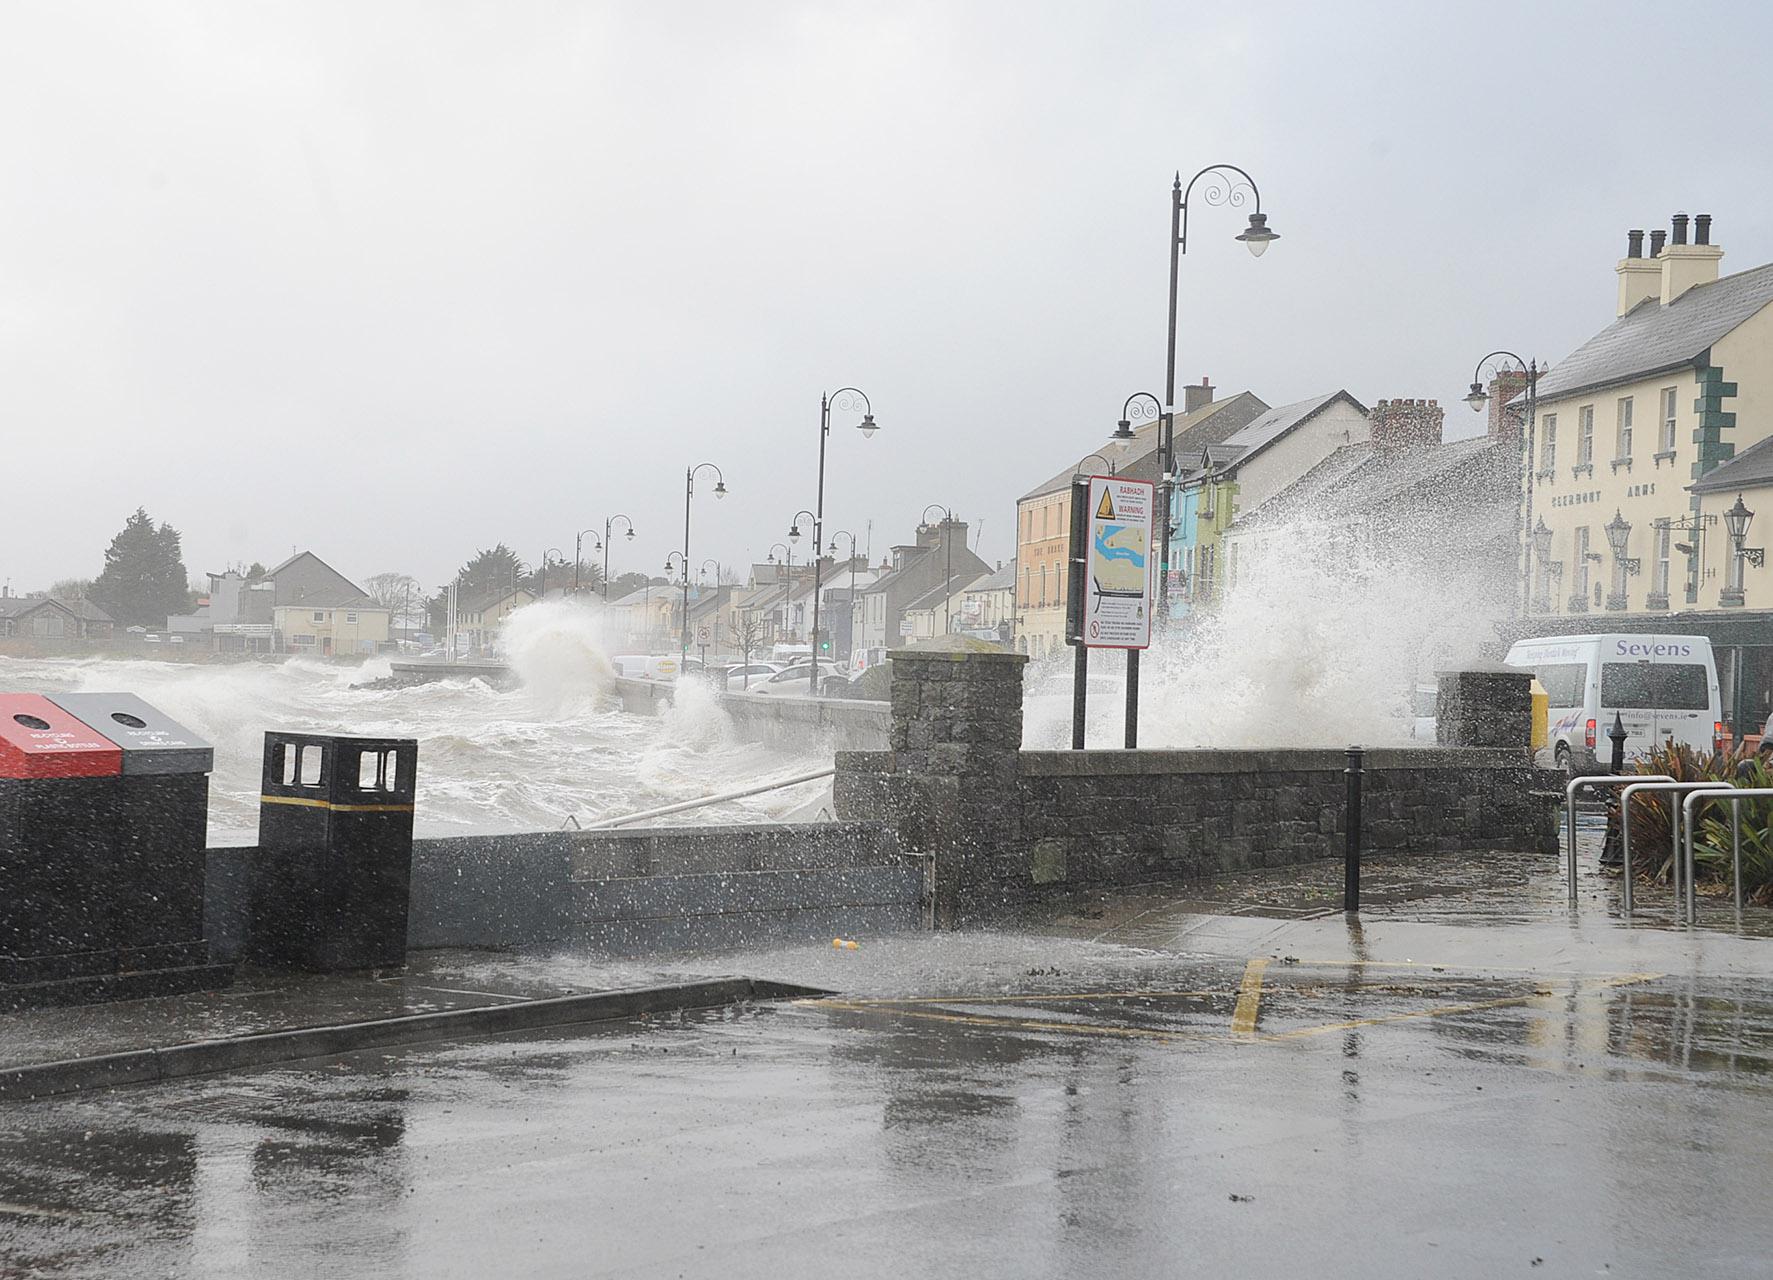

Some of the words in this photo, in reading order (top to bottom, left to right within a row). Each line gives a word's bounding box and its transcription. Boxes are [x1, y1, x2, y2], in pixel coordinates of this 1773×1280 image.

[1119, 486, 1145, 496] RABHADH
[1627, 482, 1655, 498] ARMS
[1118, 505, 1144, 515] WARNING
[1616, 639, 1691, 657] Sevens
